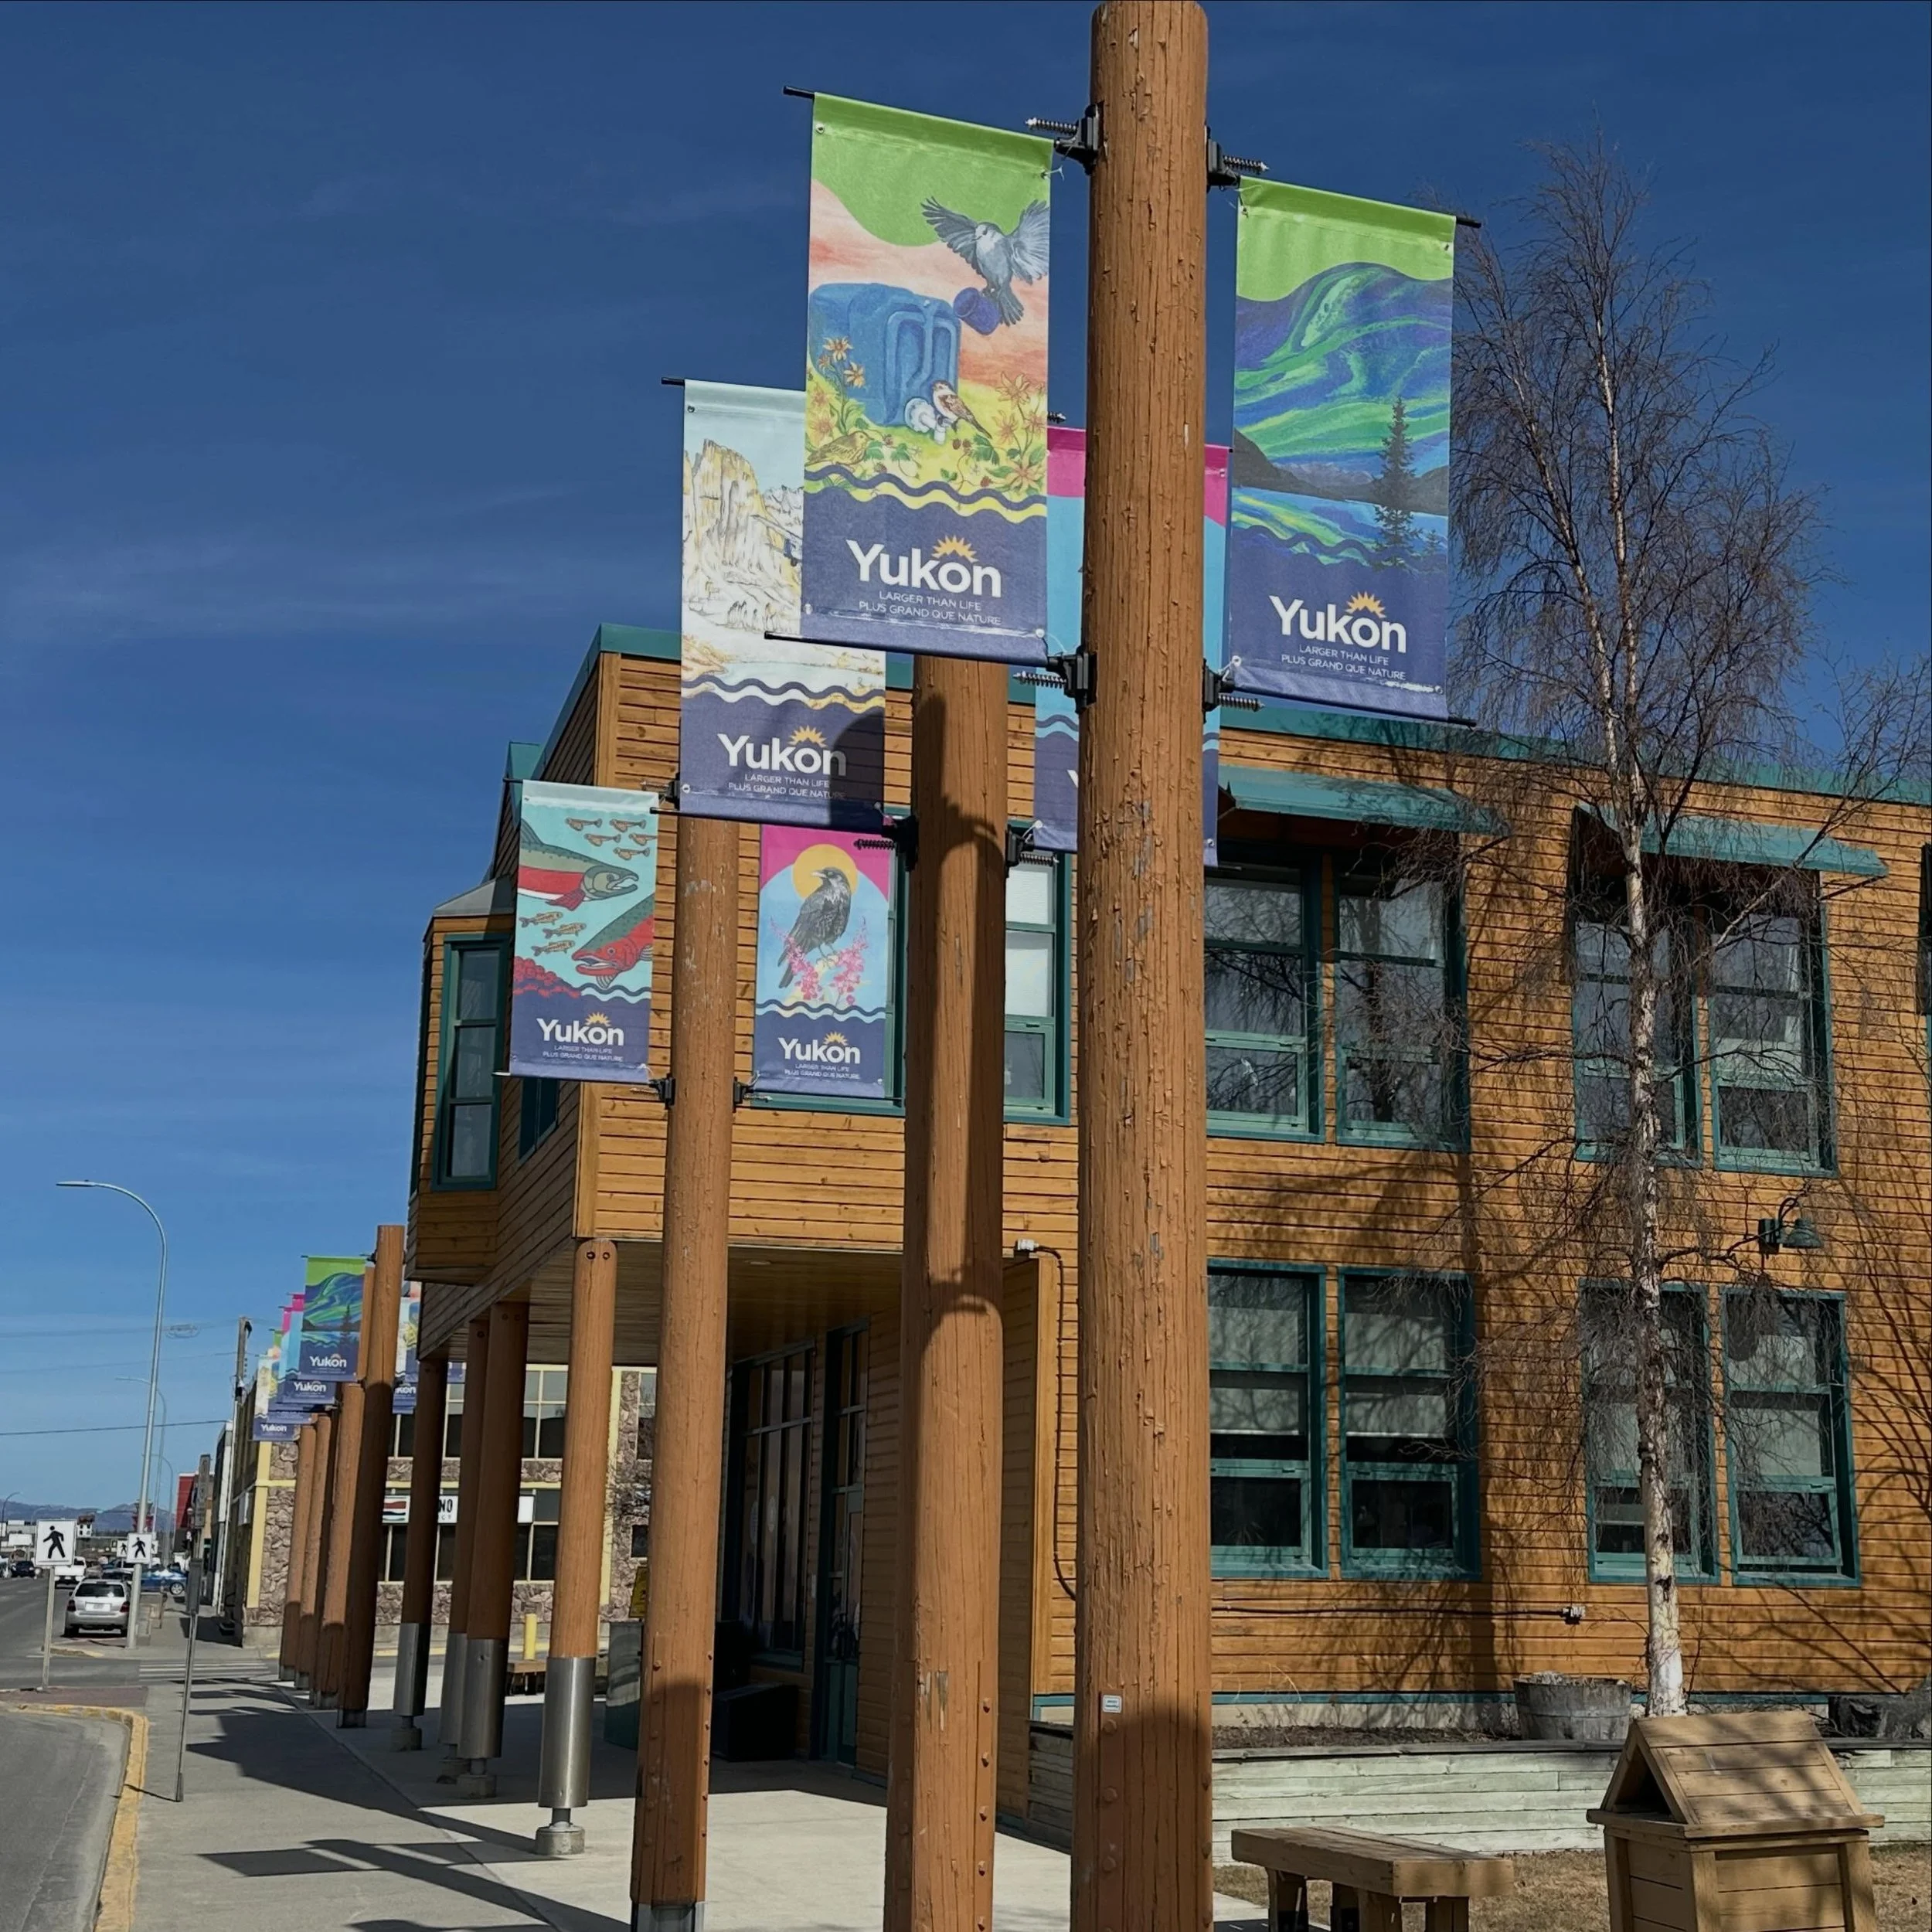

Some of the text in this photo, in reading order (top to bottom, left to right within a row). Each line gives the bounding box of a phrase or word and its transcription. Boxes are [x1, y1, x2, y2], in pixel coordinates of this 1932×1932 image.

[845, 539, 1002, 598] Yukon
[859, 600, 1002, 626] PLUS GRAND QUE NATURE
[879, 590, 981, 611] LARGER THAN LIFE
[1269, 595, 1406, 654] Yukon
[1281, 654, 1406, 681] PLUS GRAND QUE NATURE
[1299, 645, 1389, 666] LARGER THAN LIFE
[717, 733, 847, 777] Yukon
[728, 782, 846, 800] PLUS GRAND QUE NATURE
[744, 774, 830, 788] LARGER THAN LIFE
[536, 1018, 624, 1046] Yukon
[777, 1037, 860, 1064] Yukon
[309, 1355, 347, 1368] Yukon
[293, 1382, 326, 1392] Yukon
